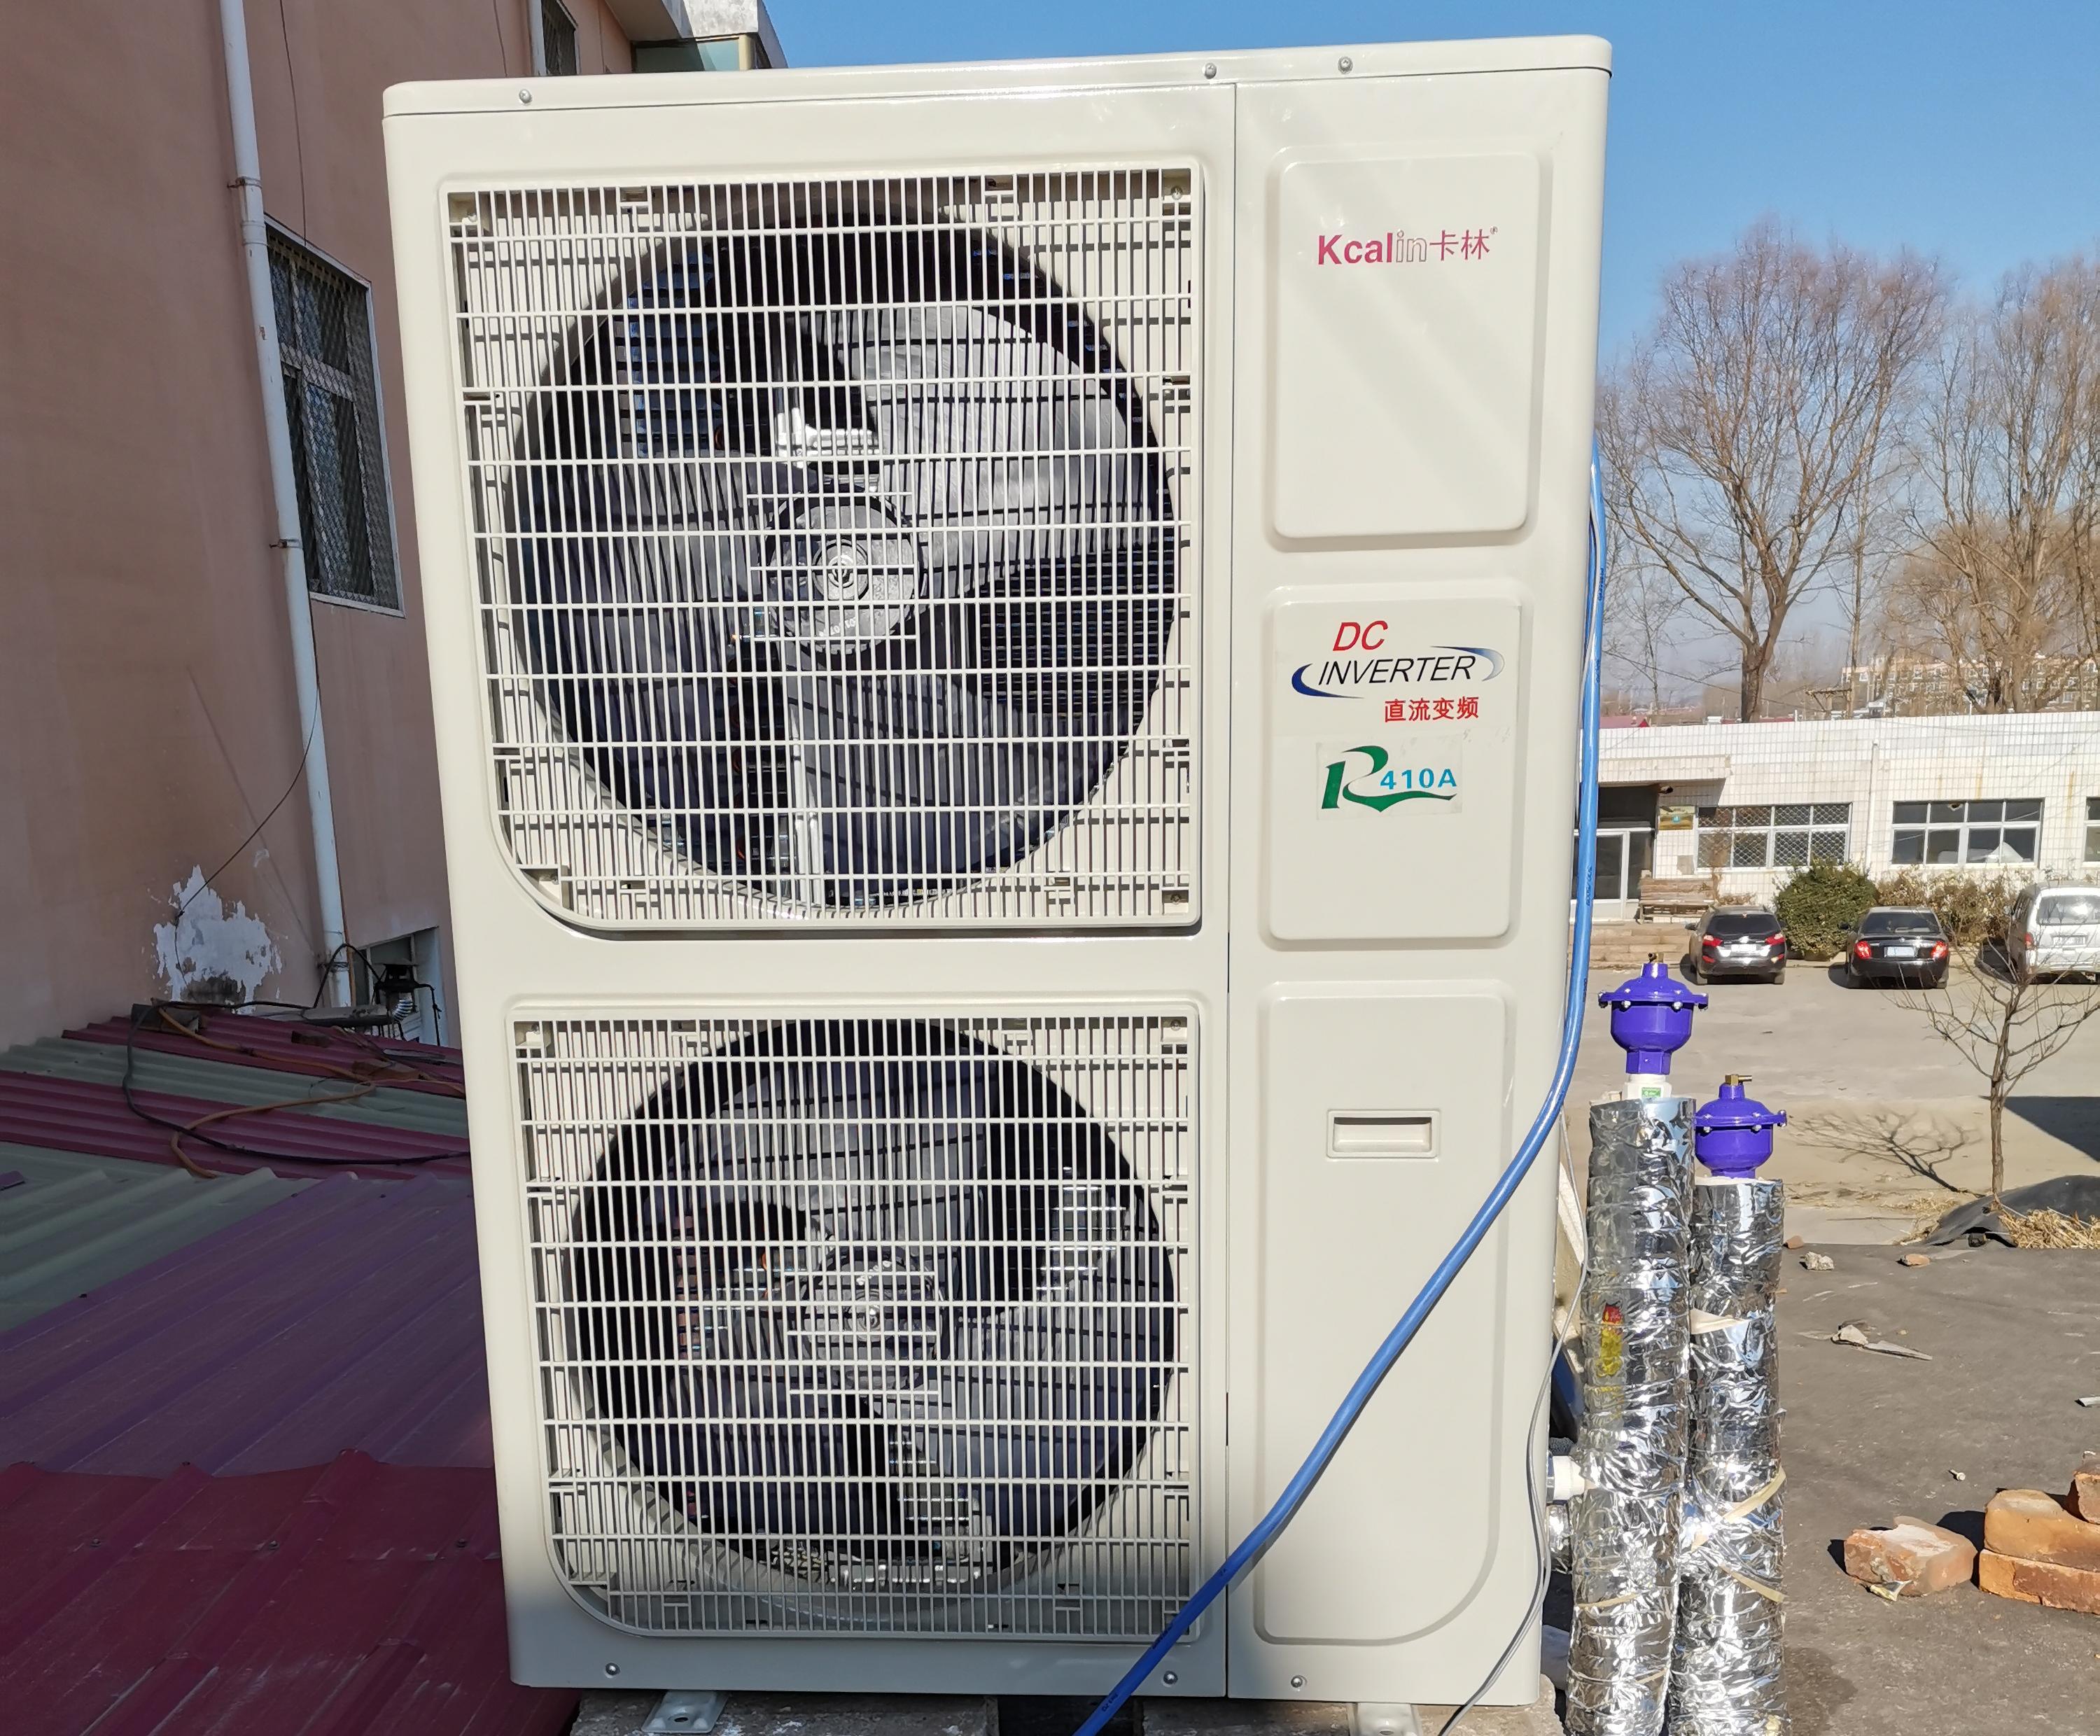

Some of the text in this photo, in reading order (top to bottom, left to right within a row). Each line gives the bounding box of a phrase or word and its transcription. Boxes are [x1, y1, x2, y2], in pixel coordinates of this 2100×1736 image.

[1318, 230, 1427, 265] Kcalin
[1333, 620, 1388, 651] DC
[1319, 655, 1476, 685] INVERTER
[1385, 696, 1479, 723] 直流变频
